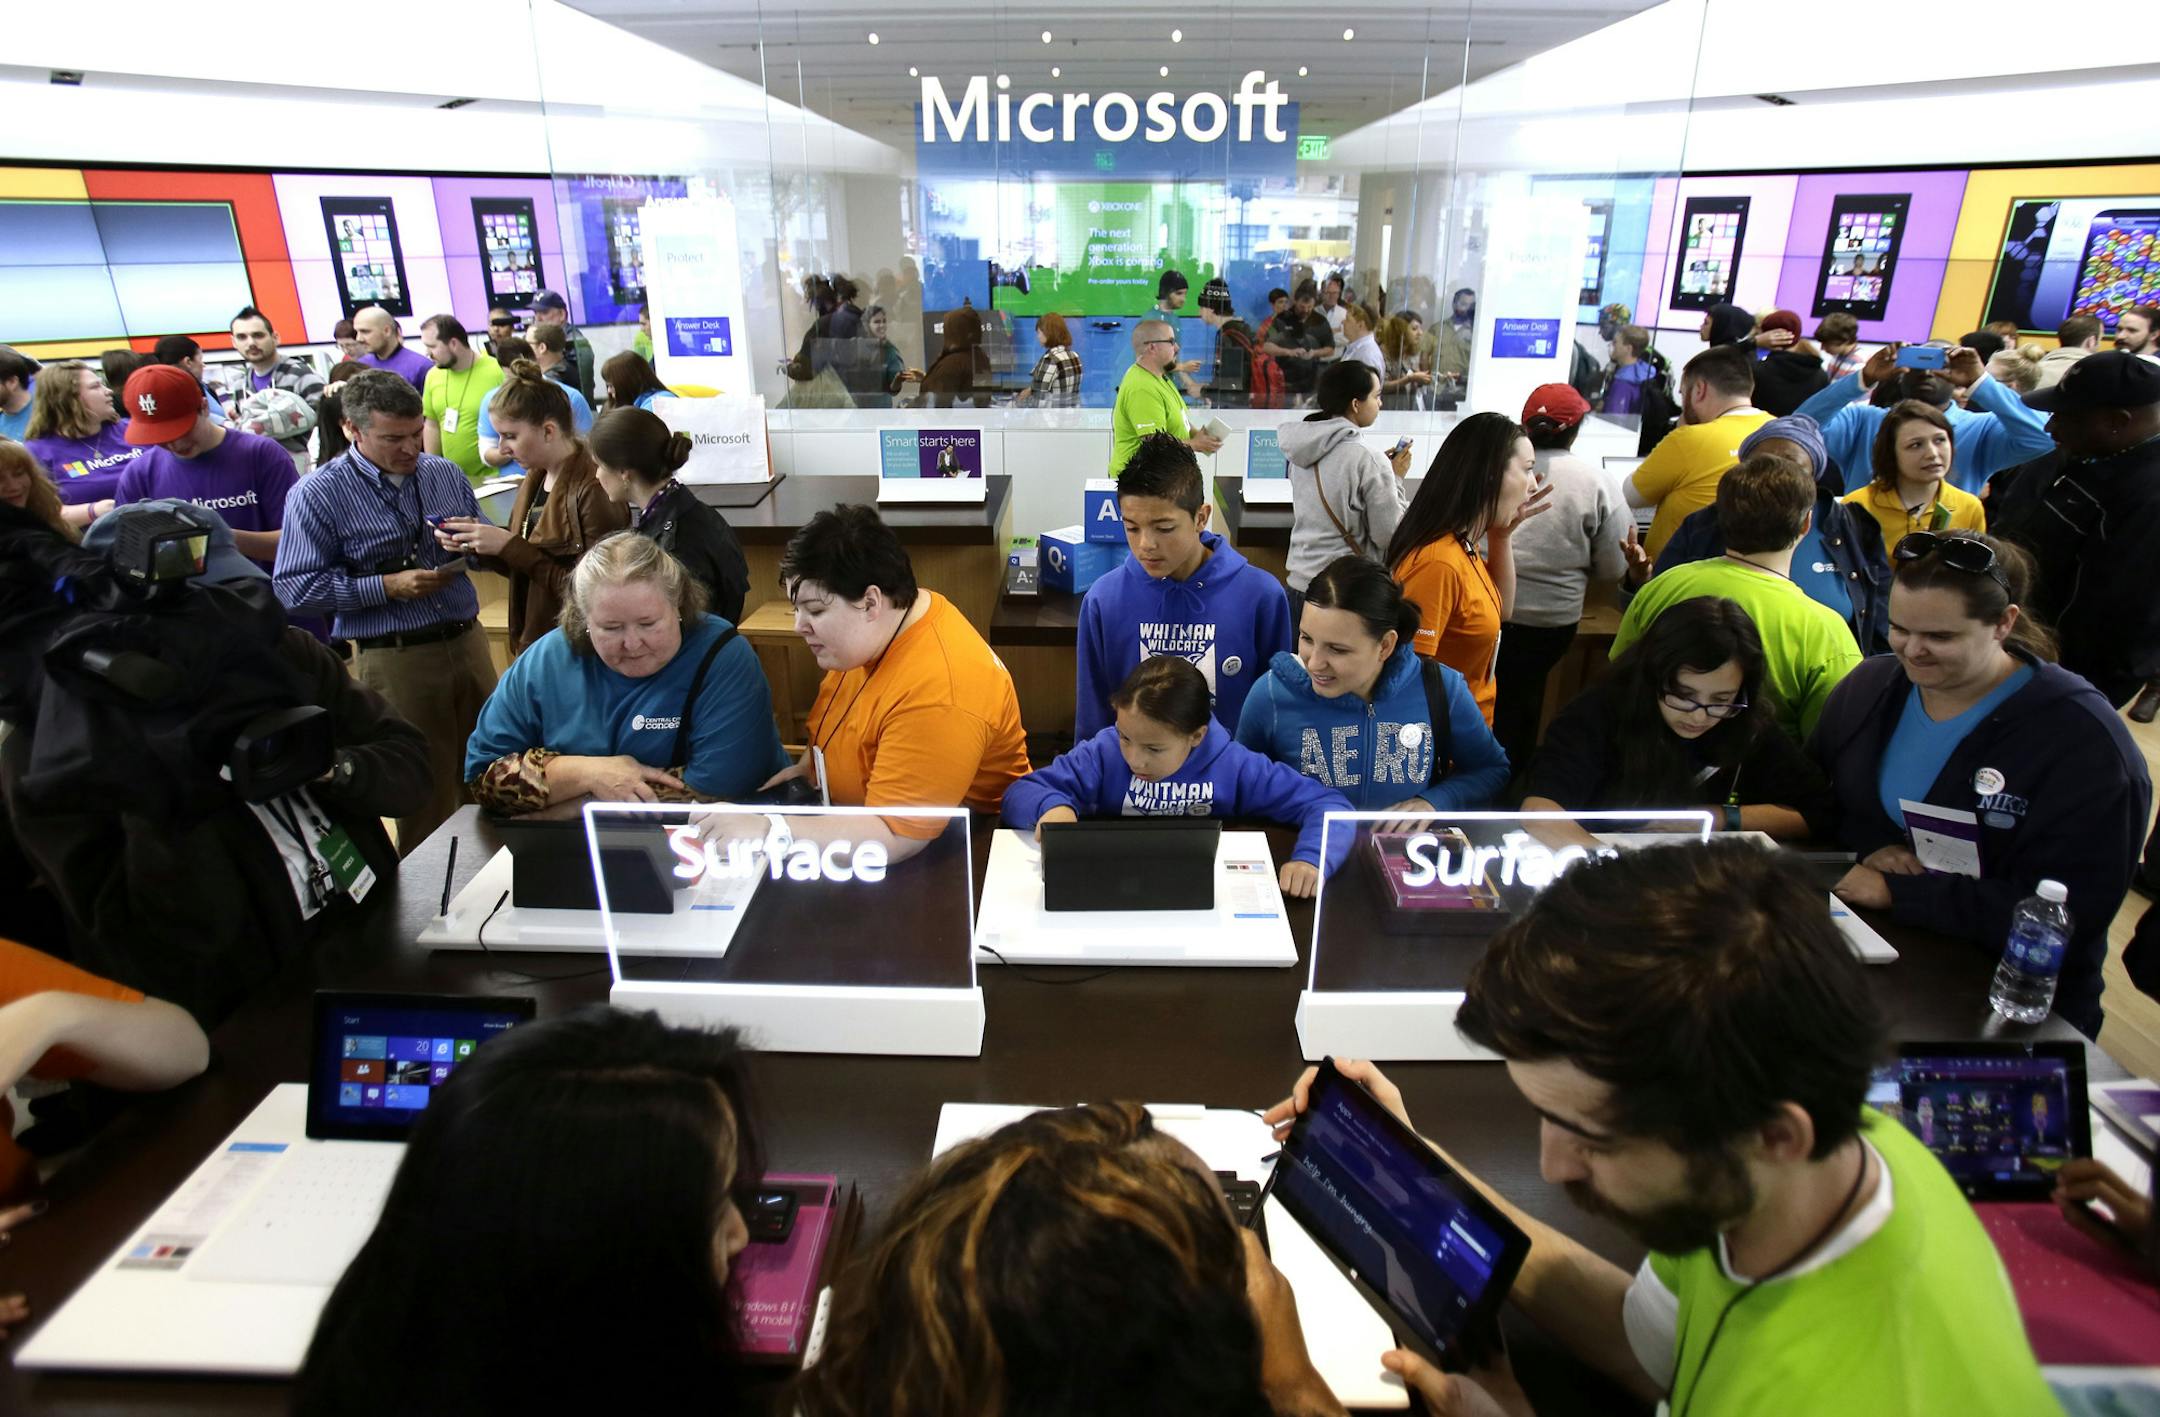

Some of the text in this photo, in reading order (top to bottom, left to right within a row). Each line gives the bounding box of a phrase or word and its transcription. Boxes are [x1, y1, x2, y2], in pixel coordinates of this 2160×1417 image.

[921, 70, 1288, 143] Microsoft
[1088, 228, 1131, 237] The next
[1088, 242, 1143, 254] generation
[1088, 256, 1163, 268] Xbox is coming
[675, 320, 720, 330] Answer Desk
[1502, 322, 1550, 331] Answer Desk
[694, 433, 751, 445] Microsoft
[885, 435, 976, 447] Smart starts here
[1254, 435, 1278, 448] Sma
[86, 448, 143, 471] Microsoft
[1048, 546, 1067, 574] Q:
[1017, 570, 1033, 583] A:
[1139, 623, 1216, 640] WHITMAN
[1148, 639, 1206, 652] WILDCATS
[645, 721, 680, 730] concer
[1301, 722, 1433, 787] AERO
[1129, 775, 1213, 801] WHITMAN
[1976, 793, 2029, 816] NIKE
[669, 826, 888, 883] Surface
[344, 1016, 360, 1024] Start
[416, 1040, 429, 1052] 20
[1303, 1156, 1321, 1178] help
